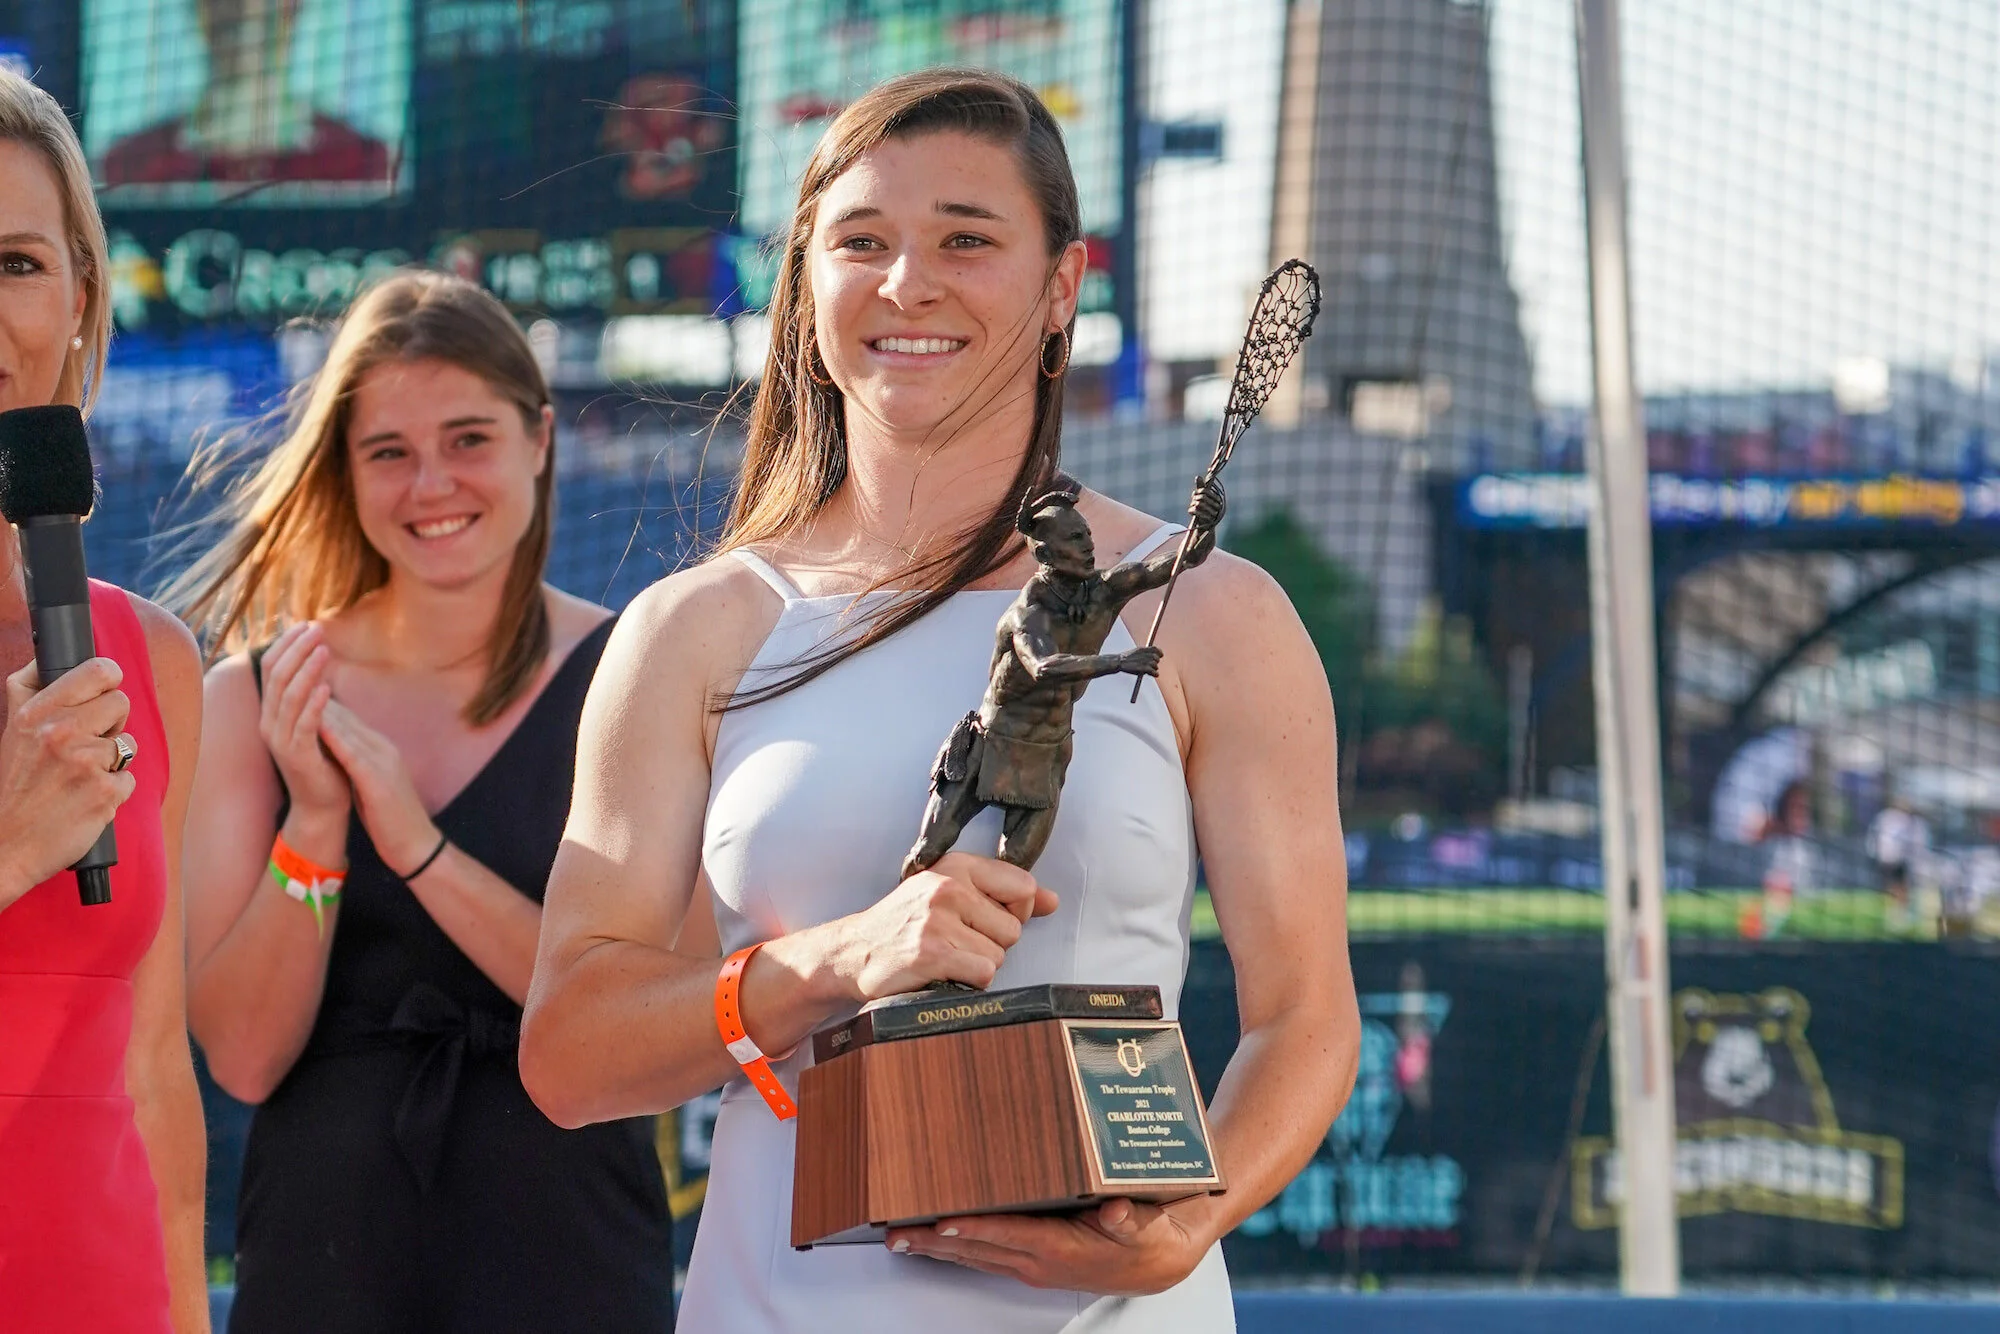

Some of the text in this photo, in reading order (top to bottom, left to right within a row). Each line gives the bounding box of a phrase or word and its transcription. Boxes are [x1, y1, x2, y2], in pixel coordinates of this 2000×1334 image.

[1089, 993, 1127, 1007] ONEIDA
[917, 1002, 1005, 1025] ONONDAGA
[1100, 1084, 1114, 1094] The
[1152, 1084, 1176, 1096] Trophy
[1135, 1099, 1150, 1109] 2021
[1107, 1111, 1184, 1122] CHARLOTTE NORTH
[1127, 1125, 1171, 1136] Boston College
[1118, 1140, 1130, 1148] The
